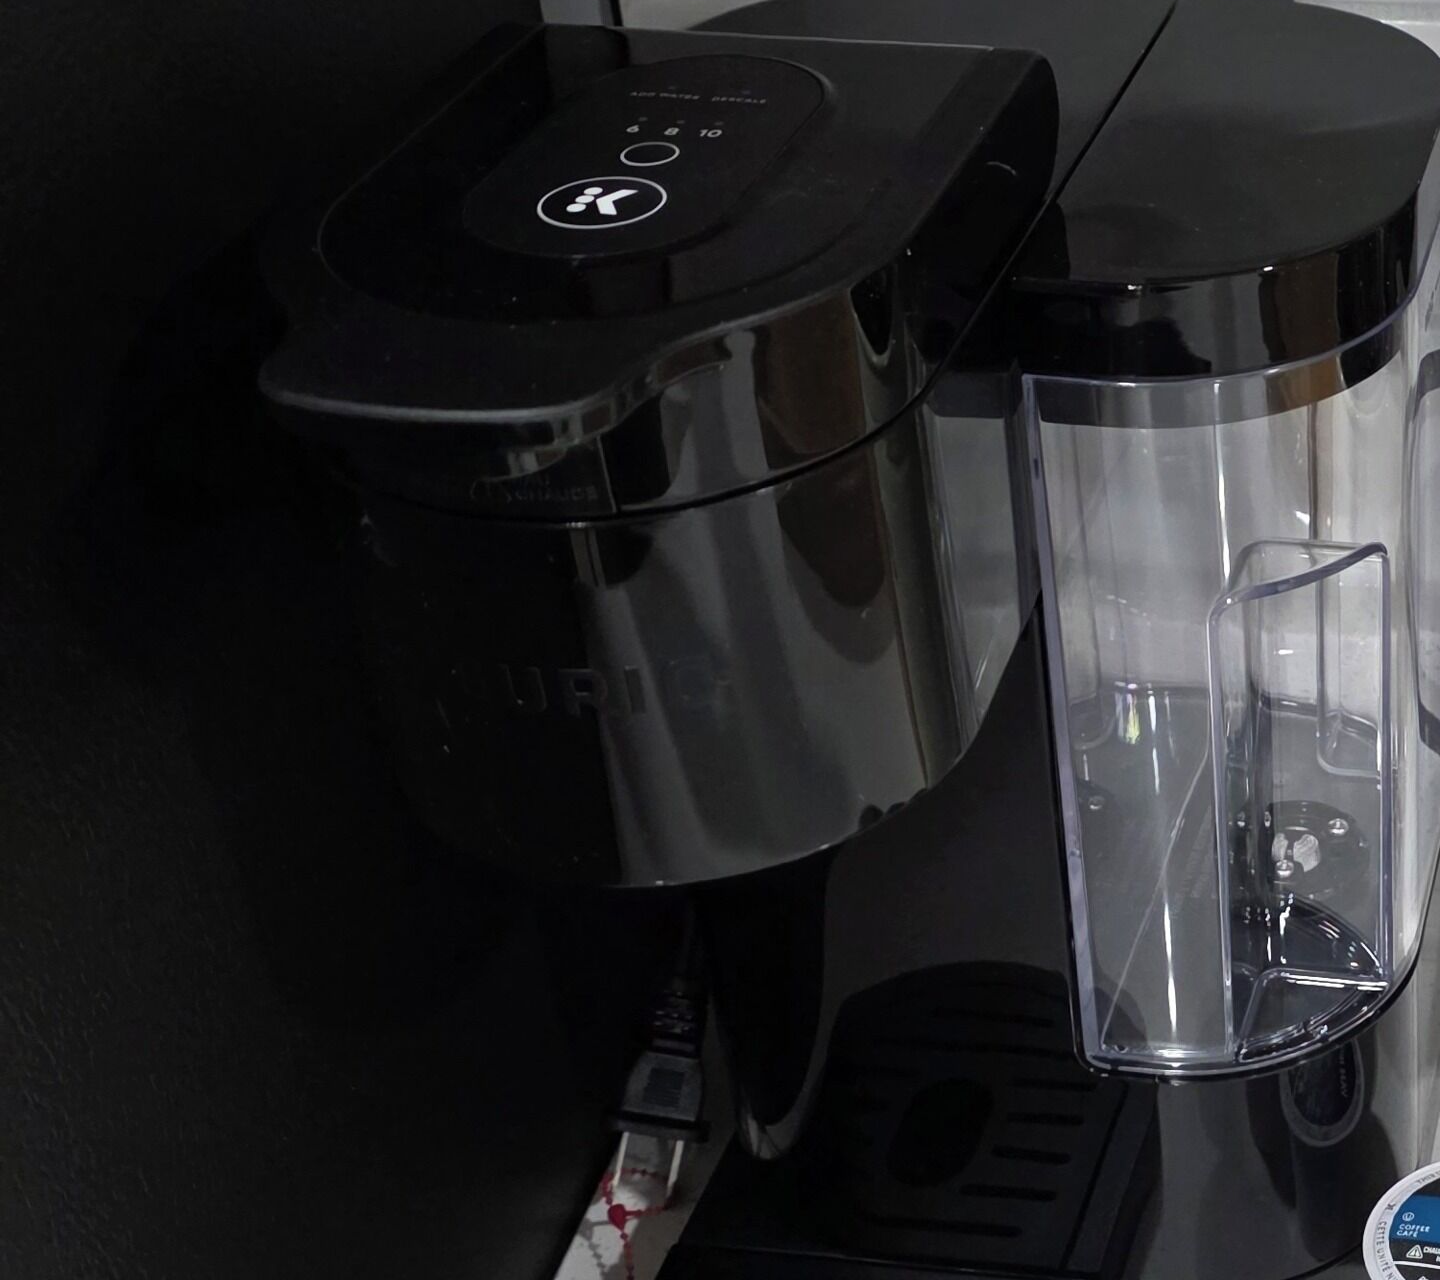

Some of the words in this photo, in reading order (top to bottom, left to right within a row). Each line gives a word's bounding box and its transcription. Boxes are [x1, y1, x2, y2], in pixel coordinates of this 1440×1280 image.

[626, 124, 640, 133] 6
[664, 127, 680, 136] 8
[700, 128, 722, 138] 10
[1399, 1223, 1431, 1233] COFFEE
[1396, 1230, 1419, 1238] CAFÉ
